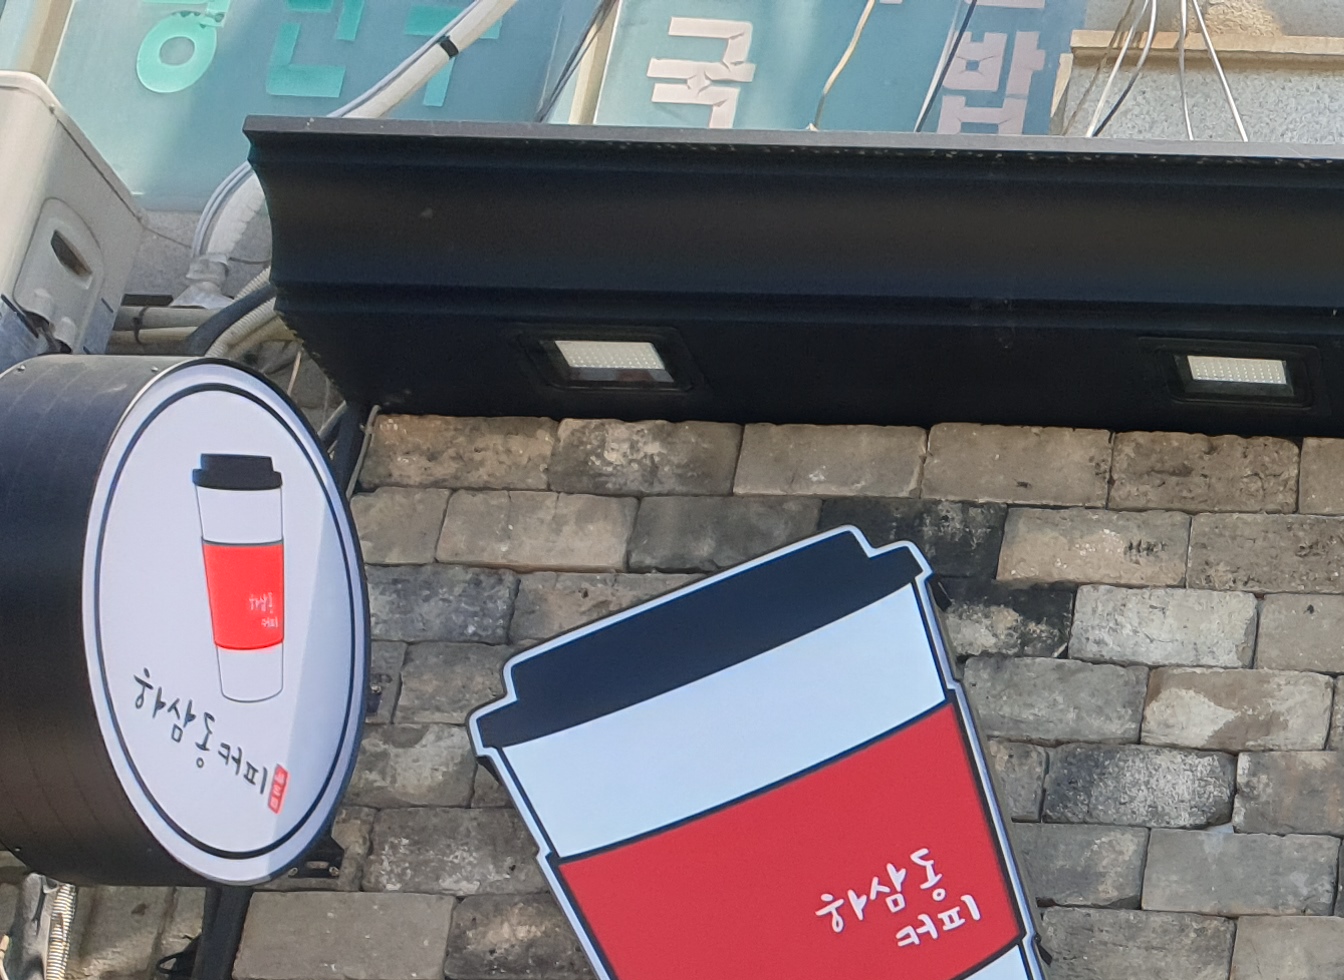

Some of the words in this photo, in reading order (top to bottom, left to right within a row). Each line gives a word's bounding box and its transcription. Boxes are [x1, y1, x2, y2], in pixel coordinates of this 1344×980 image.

[133, 667, 215, 768] 하삼동
[218, 742, 268, 794] 커피
[815, 848, 946, 933] 하삼동
[896, 894, 981, 947] 커피
